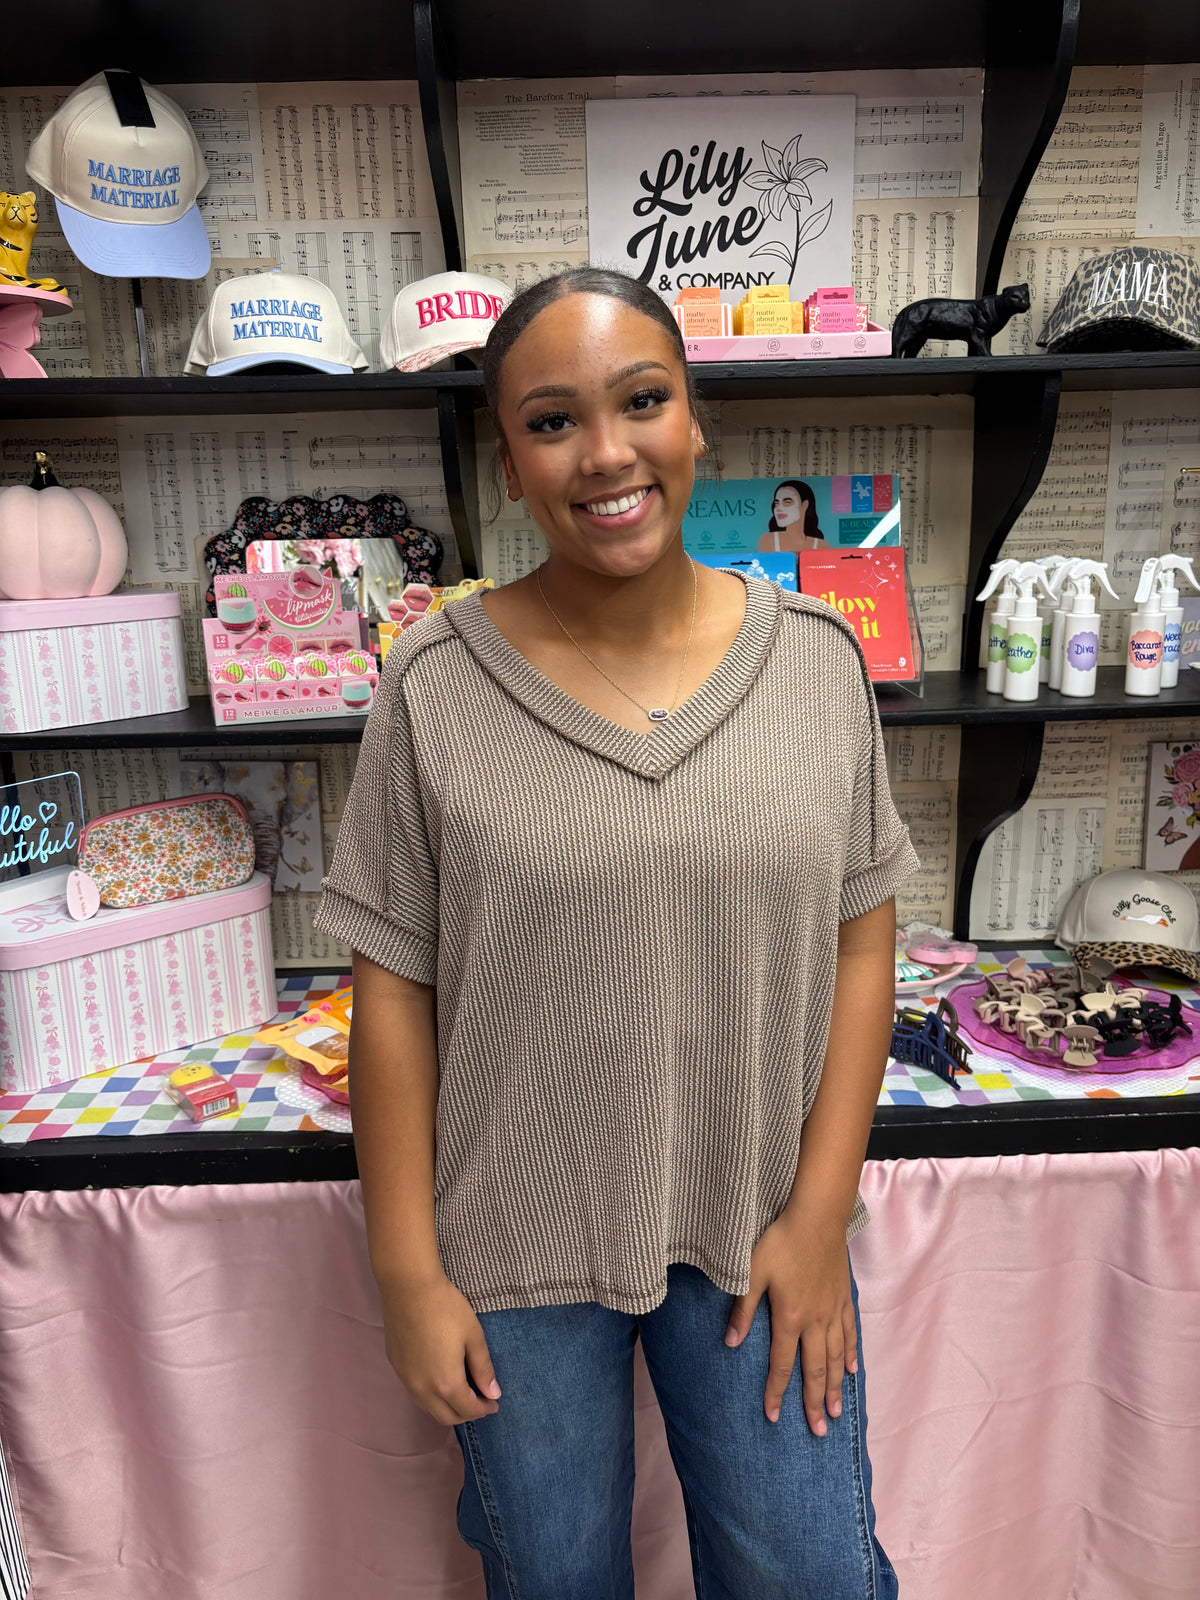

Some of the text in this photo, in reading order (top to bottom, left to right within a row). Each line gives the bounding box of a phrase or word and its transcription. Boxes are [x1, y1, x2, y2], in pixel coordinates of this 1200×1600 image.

[505, 95, 522, 104] The
[526, 92, 564, 102] Barefoot
[1154, 122, 1166, 190] Argentine Tango
[87, 158, 181, 187] MARRIAGE
[633, 140, 753, 216] Lily
[90, 183, 180, 208] MATERIAL
[627, 205, 765, 286] June
[658, 271, 776, 292] & COMPANY
[1083, 261, 1170, 312] MAMA
[230, 299, 323, 321] MARRIAGE
[706, 318, 719, 326] you
[233, 319, 323, 343] MATERIAL
[216, 635, 226, 644] 12
[861, 616, 881, 639] it
[1007, 646, 1034, 659] eather
[1075, 644, 1095, 655] Diva
[1134, 651, 1157, 664] Rouge
[0, 805, 37, 835] llo
[0, 821, 77, 868] utiful
[1132, 893, 1161, 906] Goose
[1161, 904, 1177, 924] Club
